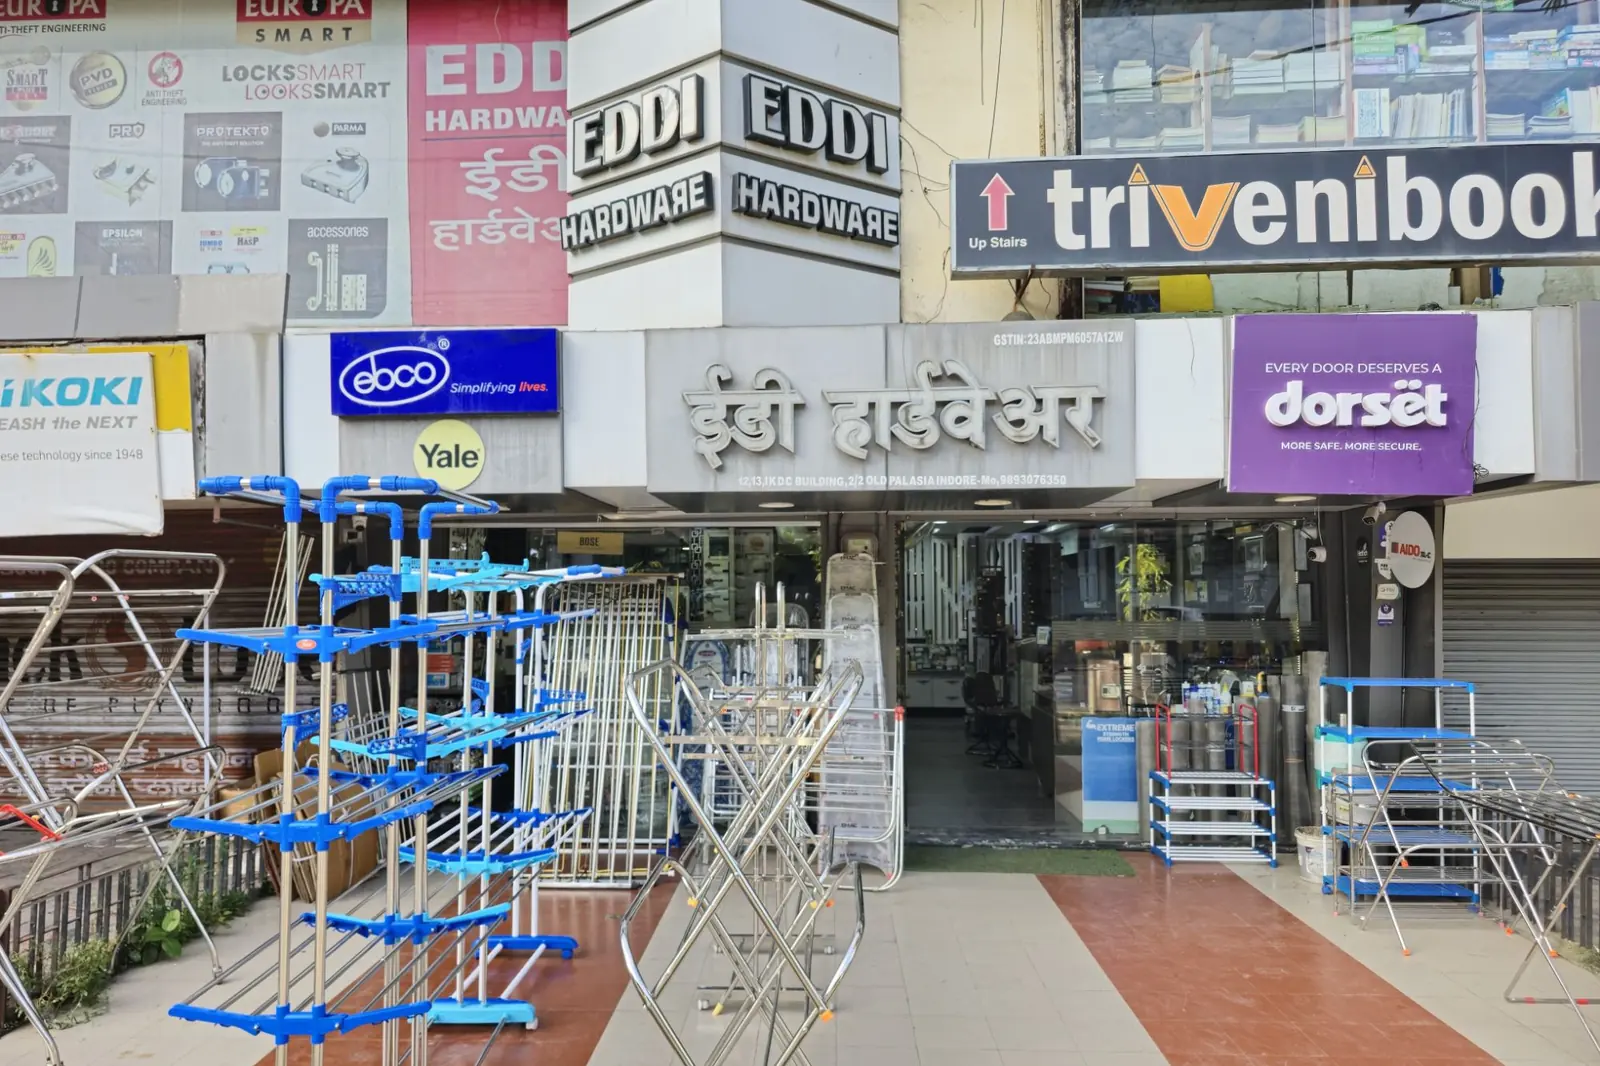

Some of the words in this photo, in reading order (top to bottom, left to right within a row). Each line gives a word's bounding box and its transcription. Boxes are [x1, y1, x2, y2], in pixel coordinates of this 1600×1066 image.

[41, 23, 107, 33] ENGINEERING
[255, 27, 353, 43] SMART
[6, 69, 48, 86] SMART
[81, 68, 113, 87] PVD
[109, 122, 145, 139] PRO
[333, 124, 365, 133] PARMA
[573, 73, 704, 178] EDDI
[743, 72, 889, 175] EDDI
[196, 126, 269, 137] PROTEKTO
[560, 171, 714, 250] HARDWARE
[732, 173, 899, 247] HARDWARE
[102, 229, 143, 238] EPSILON
[307, 226, 369, 238] accessories
[969, 238, 987, 250] Up
[990, 236, 1028, 248] Stairs
[353, 354, 437, 394] ebco
[1265, 363, 1309, 374] EVERY
[1312, 363, 1354, 374] DOOR
[1357, 363, 1429, 374] DESERVES
[1432, 363, 1442, 374] A
[450, 382, 516, 394] Simplifying
[519, 381, 549, 392] lives.
[1264, 379, 1448, 428] dorsët
[52, 416, 81, 430] the
[86, 416, 138, 430] NEXT
[681, 363, 806, 470] ईडी
[1281, 442, 1312, 450] MORE
[1313, 442, 1342, 450] SAFE.
[1344, 442, 1375, 451] MORE
[1377, 442, 1422, 451] SECURE.
[22, 450, 81, 462] technology
[84, 450, 112, 460] since
[115, 449, 143, 460] 1948
[419, 443, 479, 468] Yale
[866, 475, 887, 486] OLD
[889, 475, 933, 487] PALASIA
